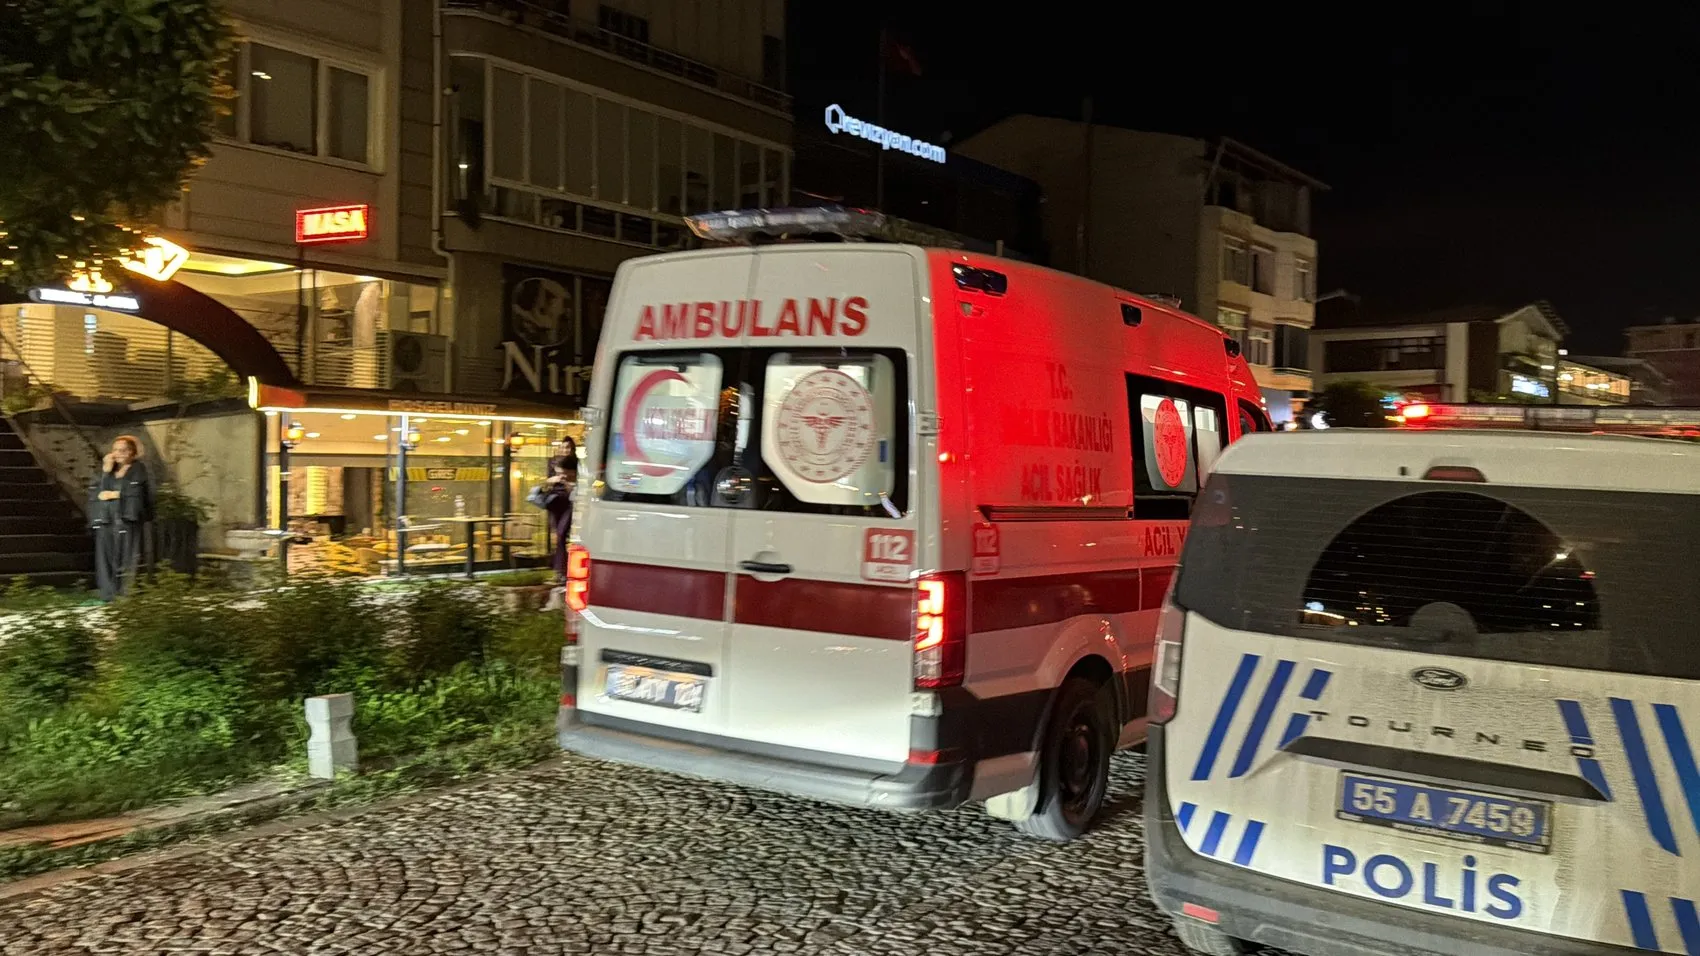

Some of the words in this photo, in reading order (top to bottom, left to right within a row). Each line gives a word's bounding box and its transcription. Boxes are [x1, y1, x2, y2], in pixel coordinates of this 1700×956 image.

[633, 296, 869, 342] AMBULANS
[869, 533, 909, 560] 112
[1309, 709, 1594, 758] TOURNEO
[1352, 782, 1397, 814] 55
[1408, 792, 1433, 821] A
[1446, 796, 1536, 837] 7459
[1322, 843, 1523, 920] POLİS
